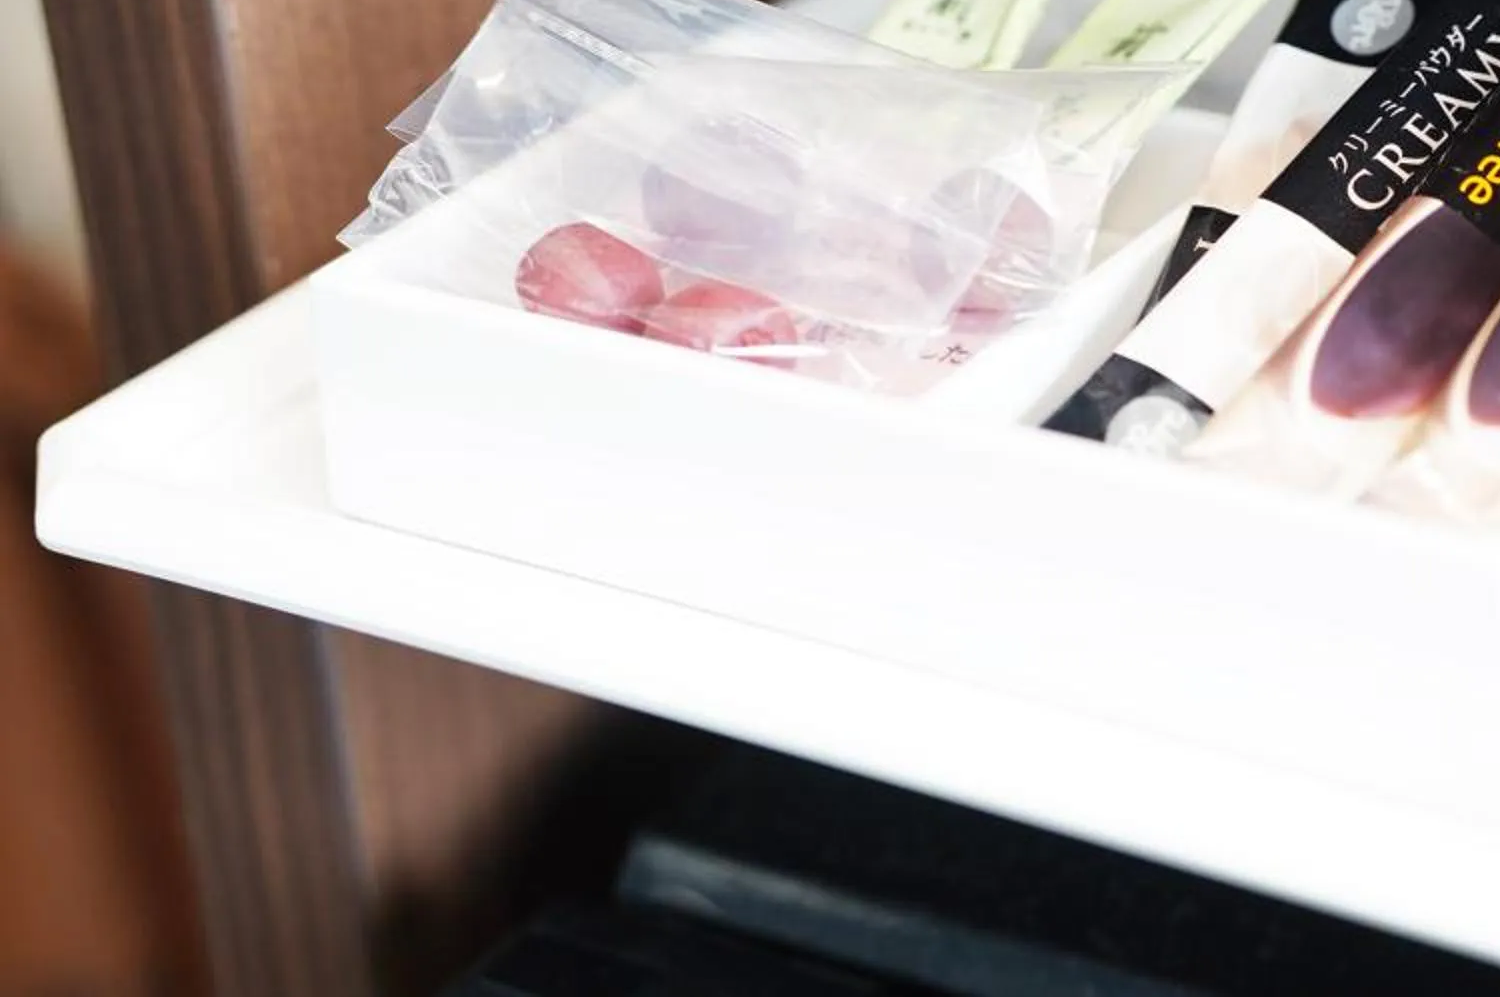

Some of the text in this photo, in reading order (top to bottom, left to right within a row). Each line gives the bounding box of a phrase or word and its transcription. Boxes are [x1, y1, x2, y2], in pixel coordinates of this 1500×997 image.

[1328, 13, 1484, 173] クリーミーパウダー
